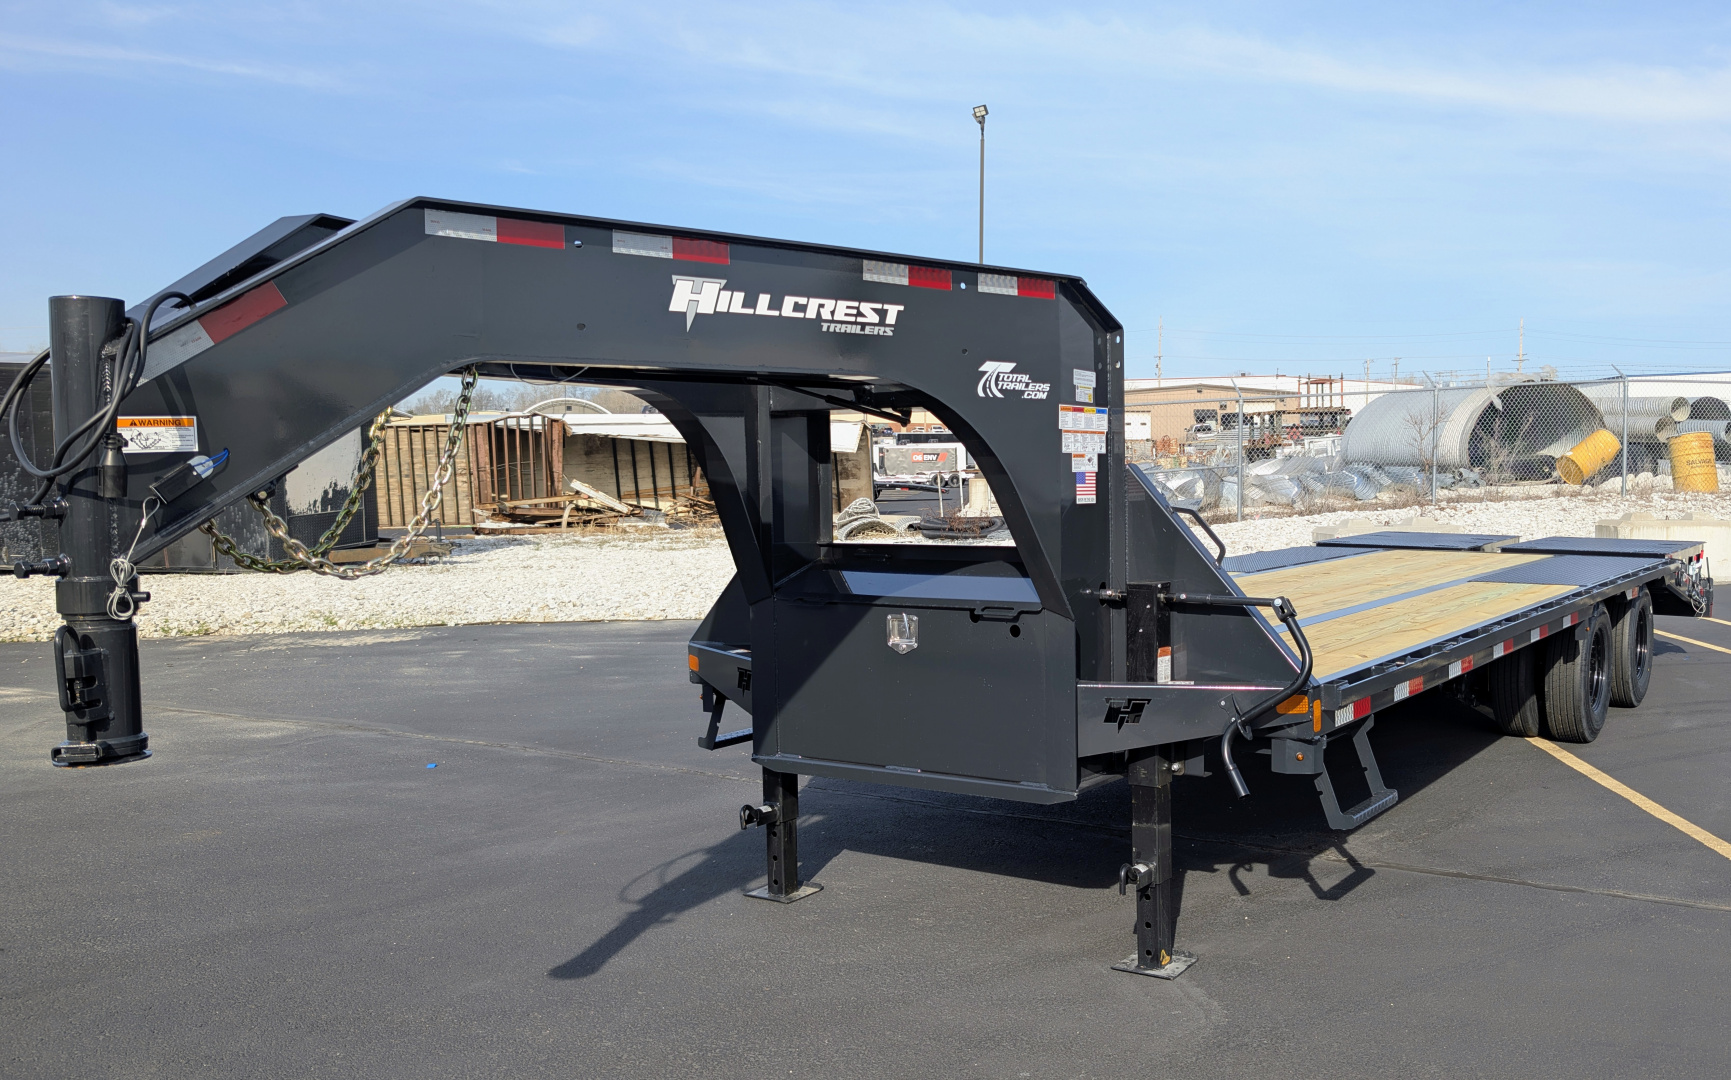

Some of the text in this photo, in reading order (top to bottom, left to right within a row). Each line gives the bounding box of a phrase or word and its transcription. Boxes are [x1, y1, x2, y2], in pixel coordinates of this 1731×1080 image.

[669, 275, 905, 332] HILLCREST
[821, 322, 895, 336] TRAILERS
[998, 373, 1032, 382] TOTAL
[997, 381, 1051, 392] TRAILERS
[1021, 391, 1048, 399] .COM
